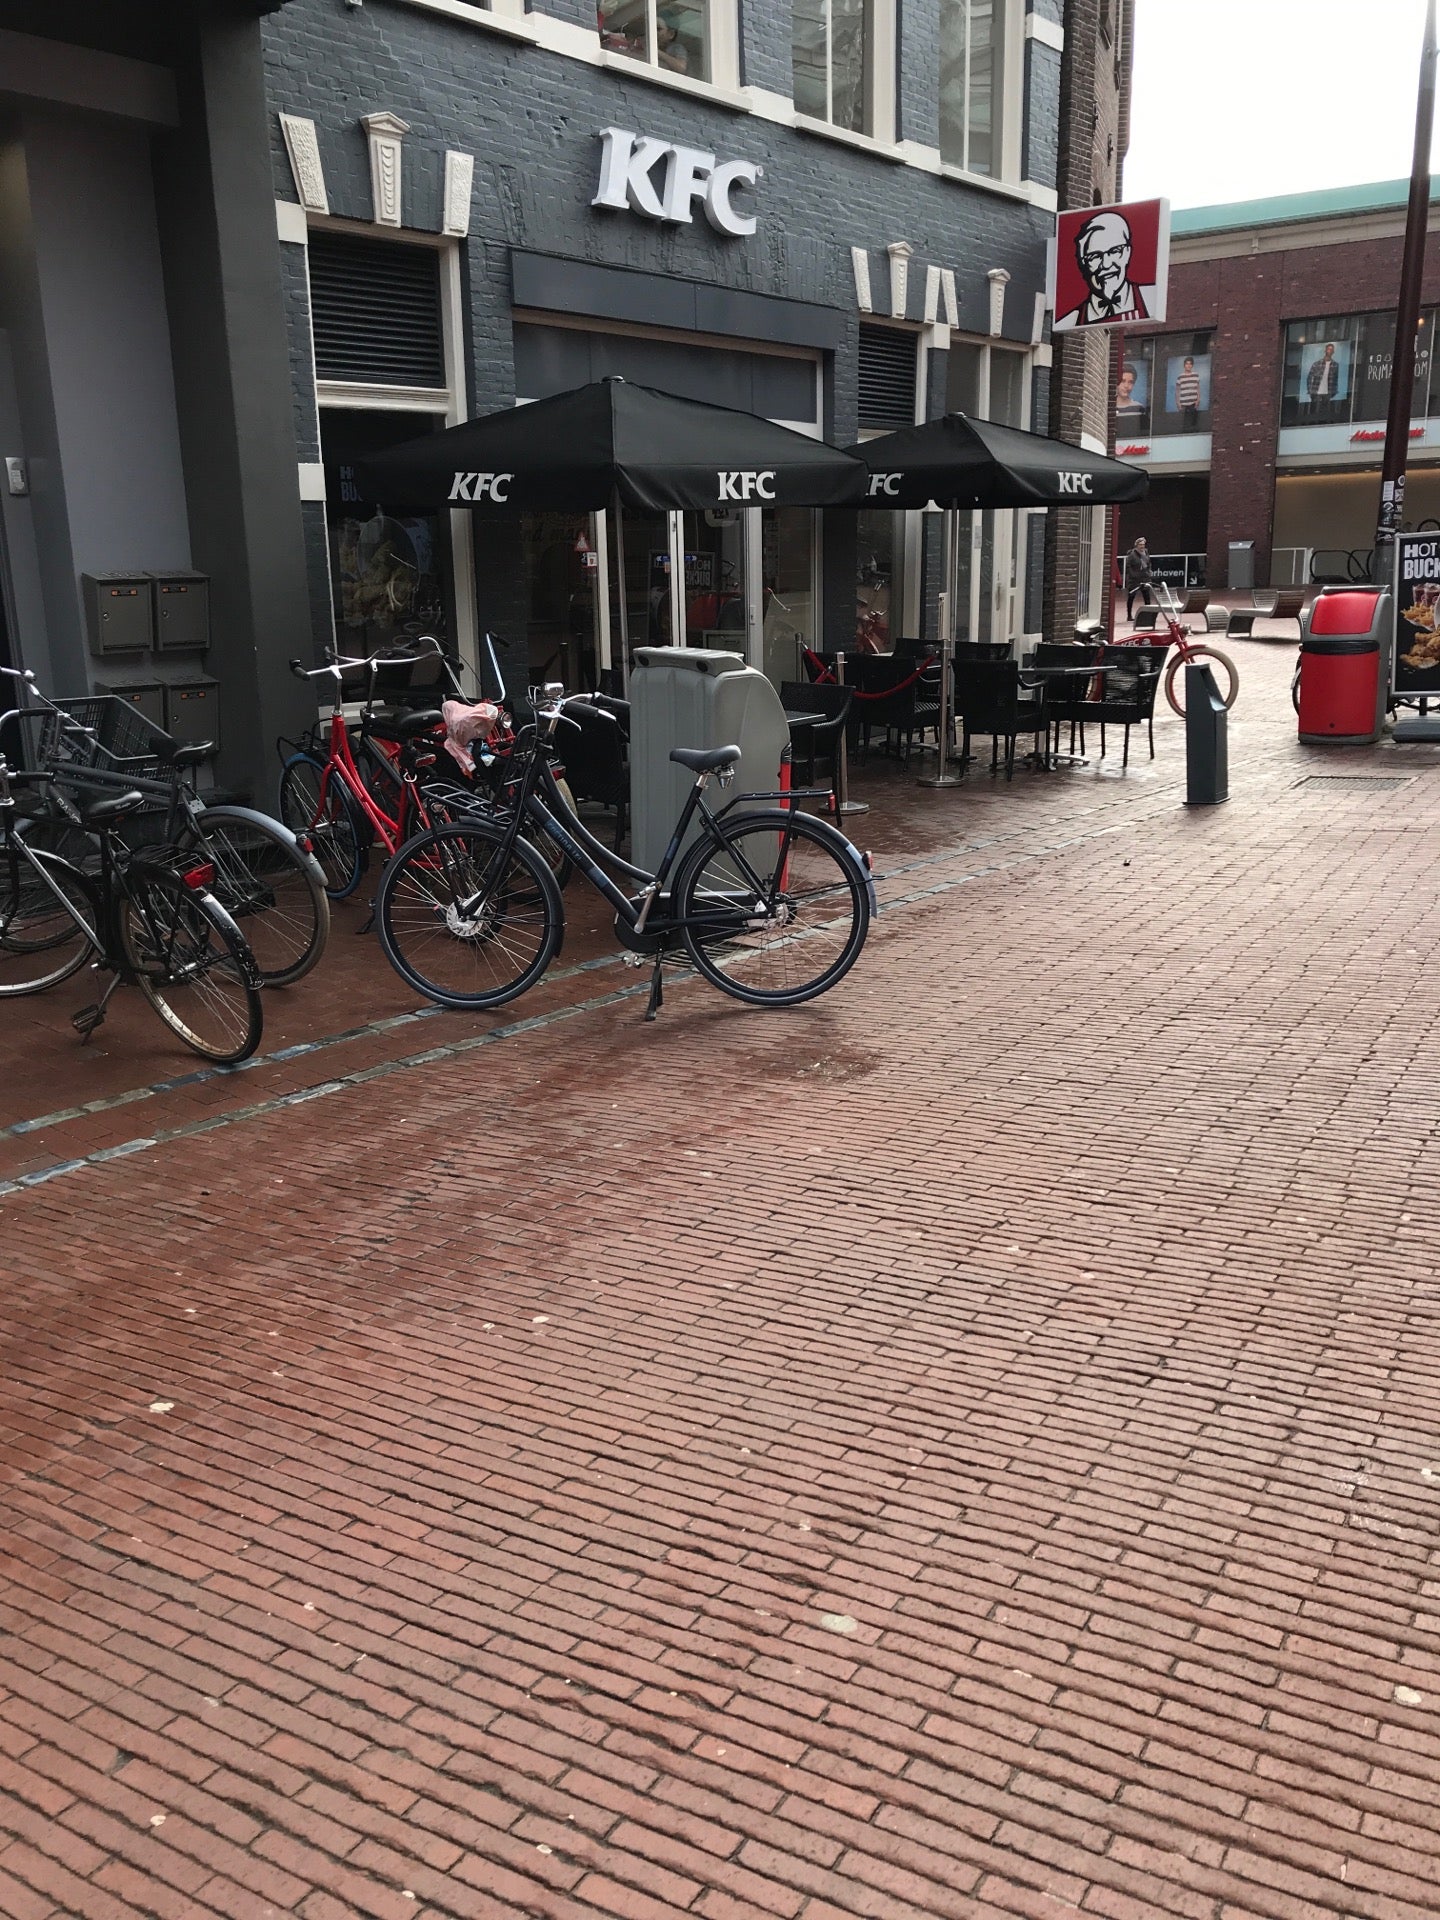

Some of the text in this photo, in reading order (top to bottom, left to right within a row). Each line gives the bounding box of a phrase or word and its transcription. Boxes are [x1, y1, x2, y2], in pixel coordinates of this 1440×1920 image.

[591, 126, 757, 237] KFC
[1367, 360, 1428, 380] PRIMAOM
[447, 471, 513, 503] KFC
[717, 471, 776, 500] KFC
[866, 473, 902, 496] FC
[1057, 471, 1093, 494] KFC
[1404, 542, 1438, 558] HOT
